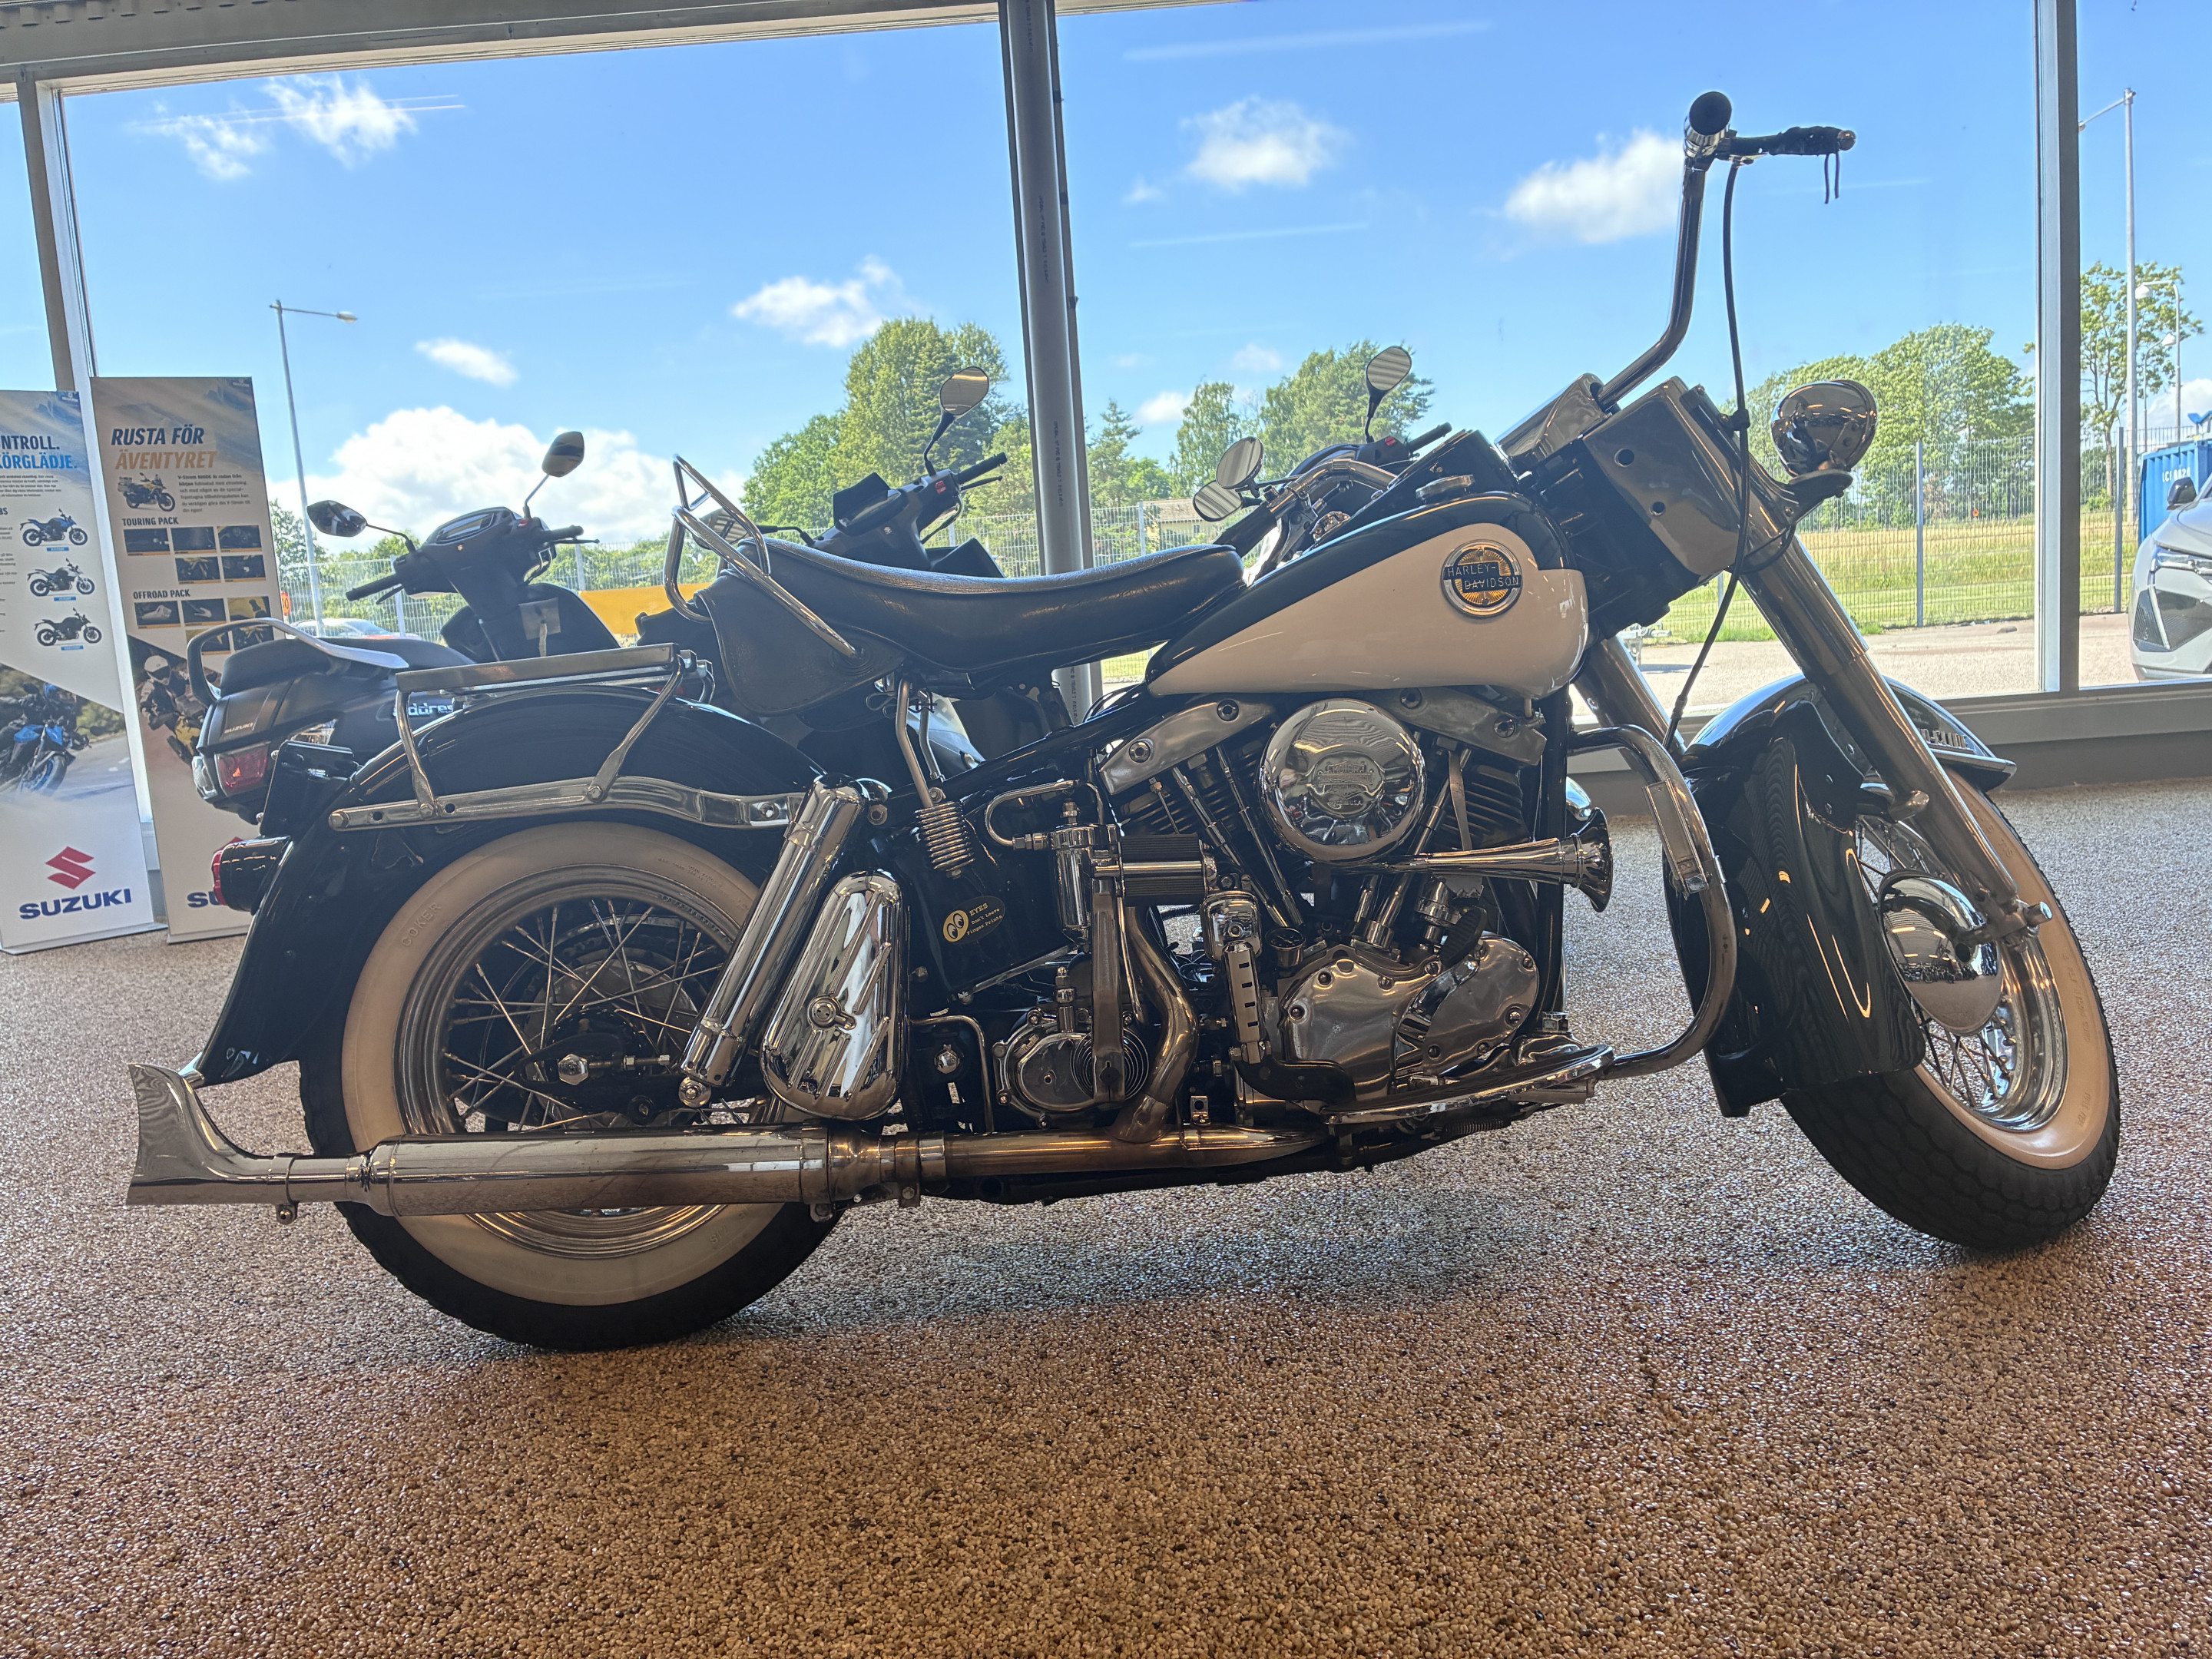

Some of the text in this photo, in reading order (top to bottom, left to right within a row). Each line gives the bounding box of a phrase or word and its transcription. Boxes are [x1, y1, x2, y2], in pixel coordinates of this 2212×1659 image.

[111, 424, 205, 445] RUSTA FÖR
[1, 435, 60, 450] NTROLL.
[115, 449, 218, 470] ÄVENTYRET
[121, 516, 179, 526] TOURING PACK
[1447, 563, 1496, 577] HARLEY-
[1464, 576, 1519, 590] DAVIDSON
[133, 589, 191, 600] OFFROAD PACK
[18, 888, 132, 920] SUZUKI
[969, 902, 988, 917] EYES
[971, 908, 1000, 925] Don't Leave
[985, 915, 1002, 926] Prints
[401, 902, 442, 947] COKER
